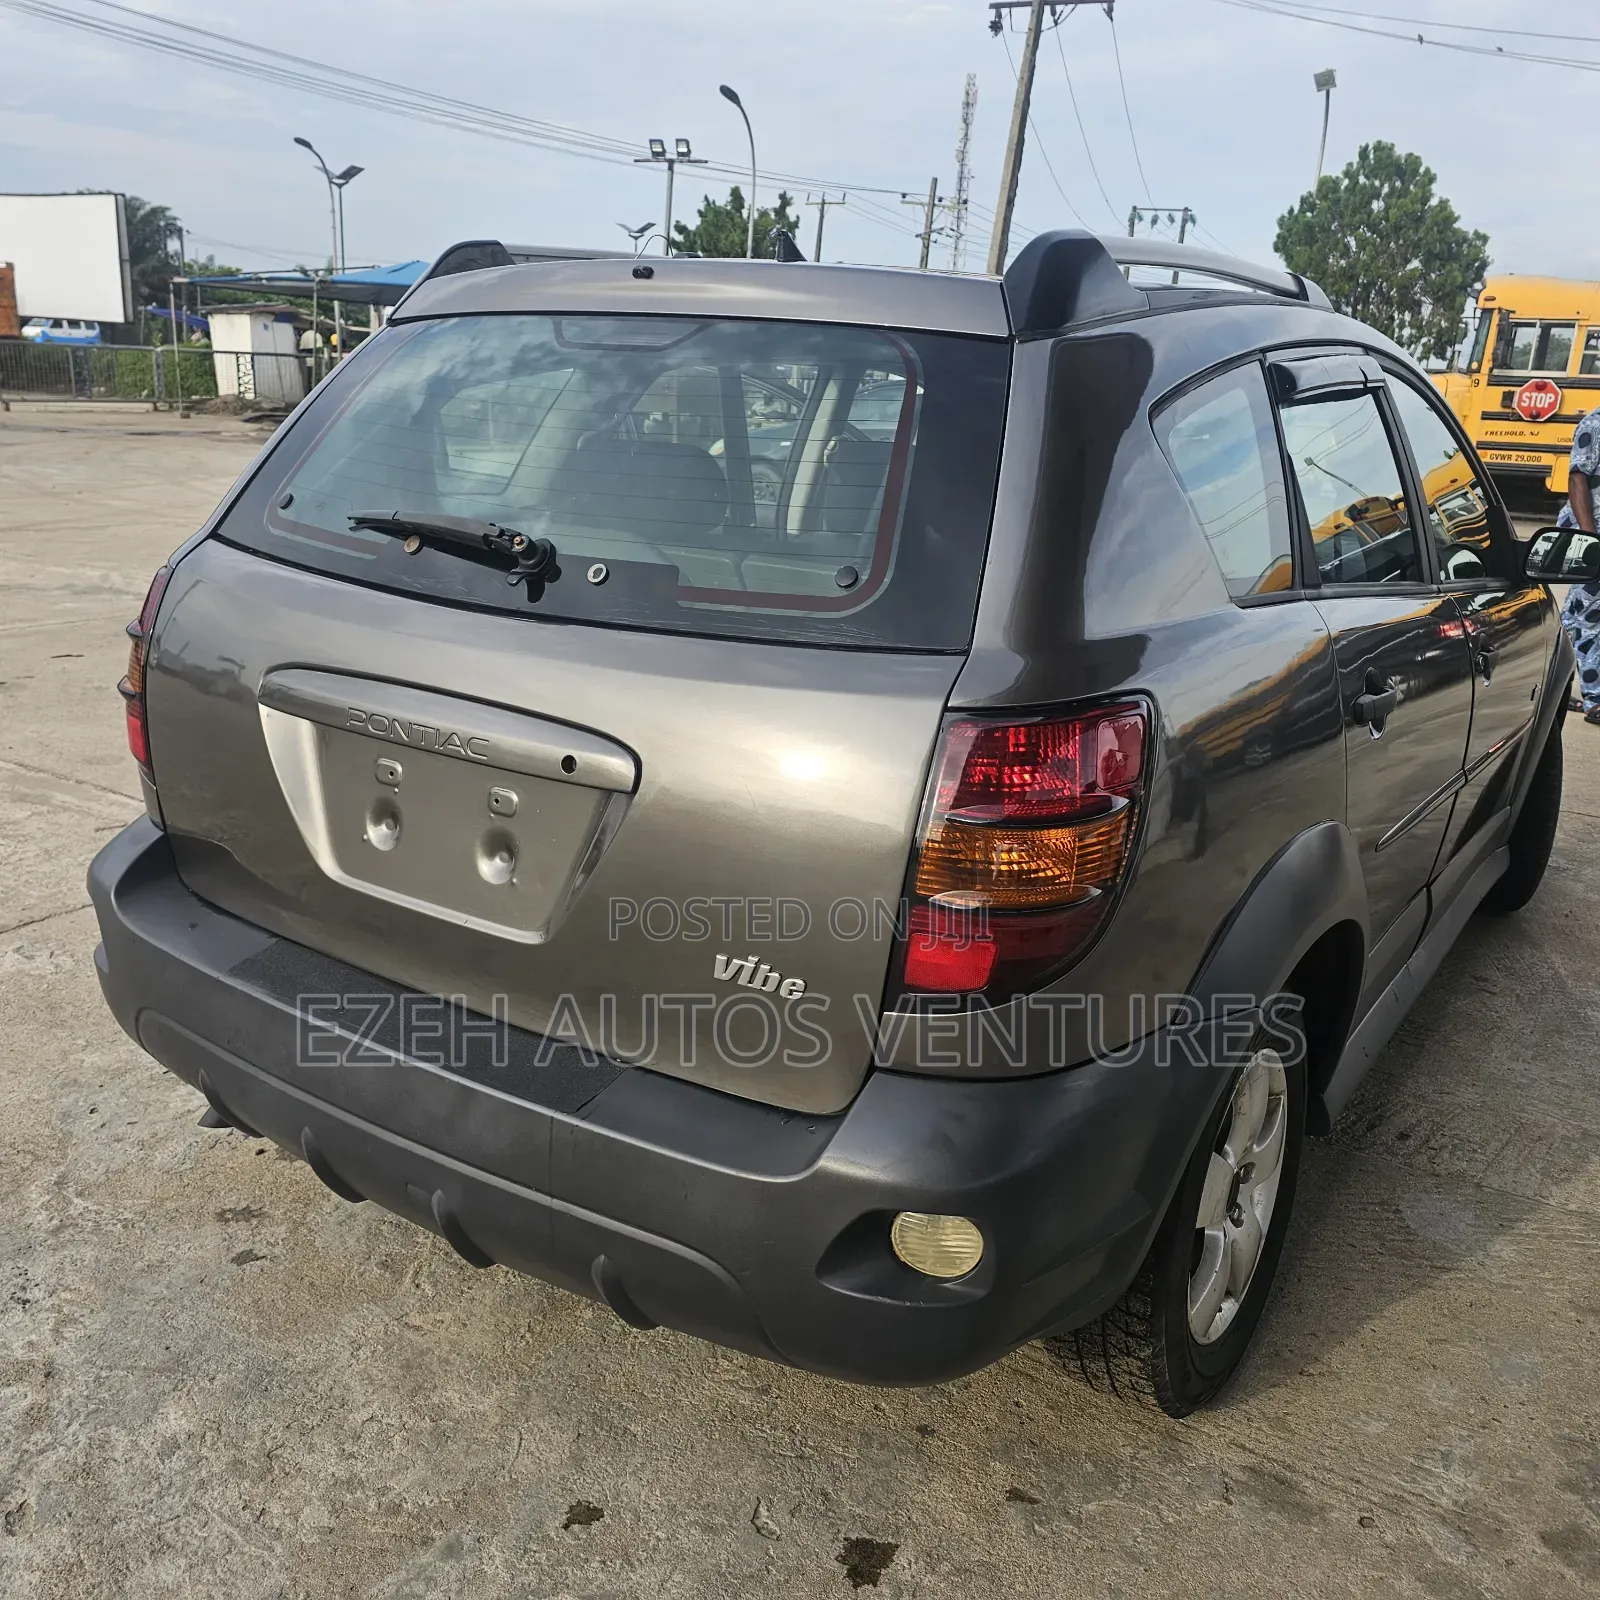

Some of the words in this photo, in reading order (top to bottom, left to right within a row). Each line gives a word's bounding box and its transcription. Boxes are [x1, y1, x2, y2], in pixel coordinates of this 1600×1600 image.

[1520, 391, 1556, 409] STOP
[1489, 453, 1513, 462] GVWR
[1514, 454, 1542, 463] 29,000
[345, 706, 490, 760] PONTIAC
[712, 952, 808, 1001] vibe
